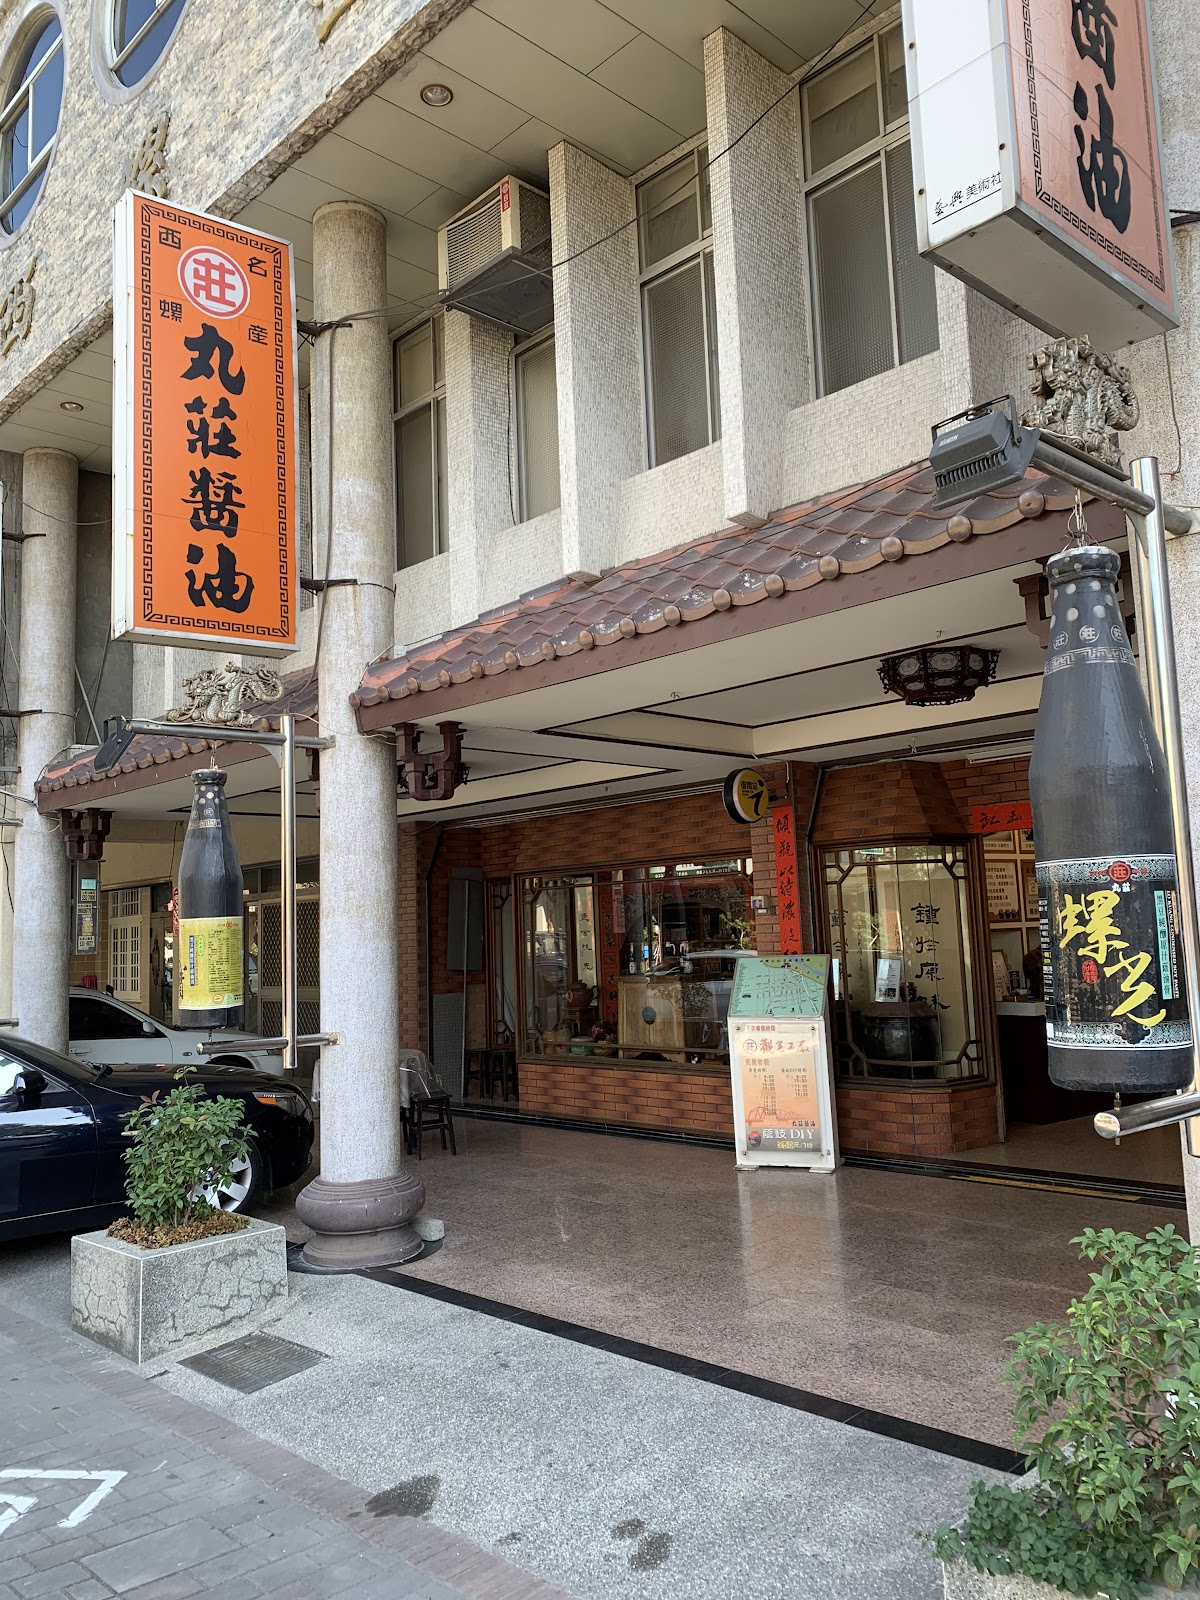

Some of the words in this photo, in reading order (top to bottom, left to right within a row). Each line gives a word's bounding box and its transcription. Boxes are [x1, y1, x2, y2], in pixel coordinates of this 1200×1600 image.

[180, 322, 255, 614] 丸莊醬油
[790, 1129, 815, 1140] DIY
